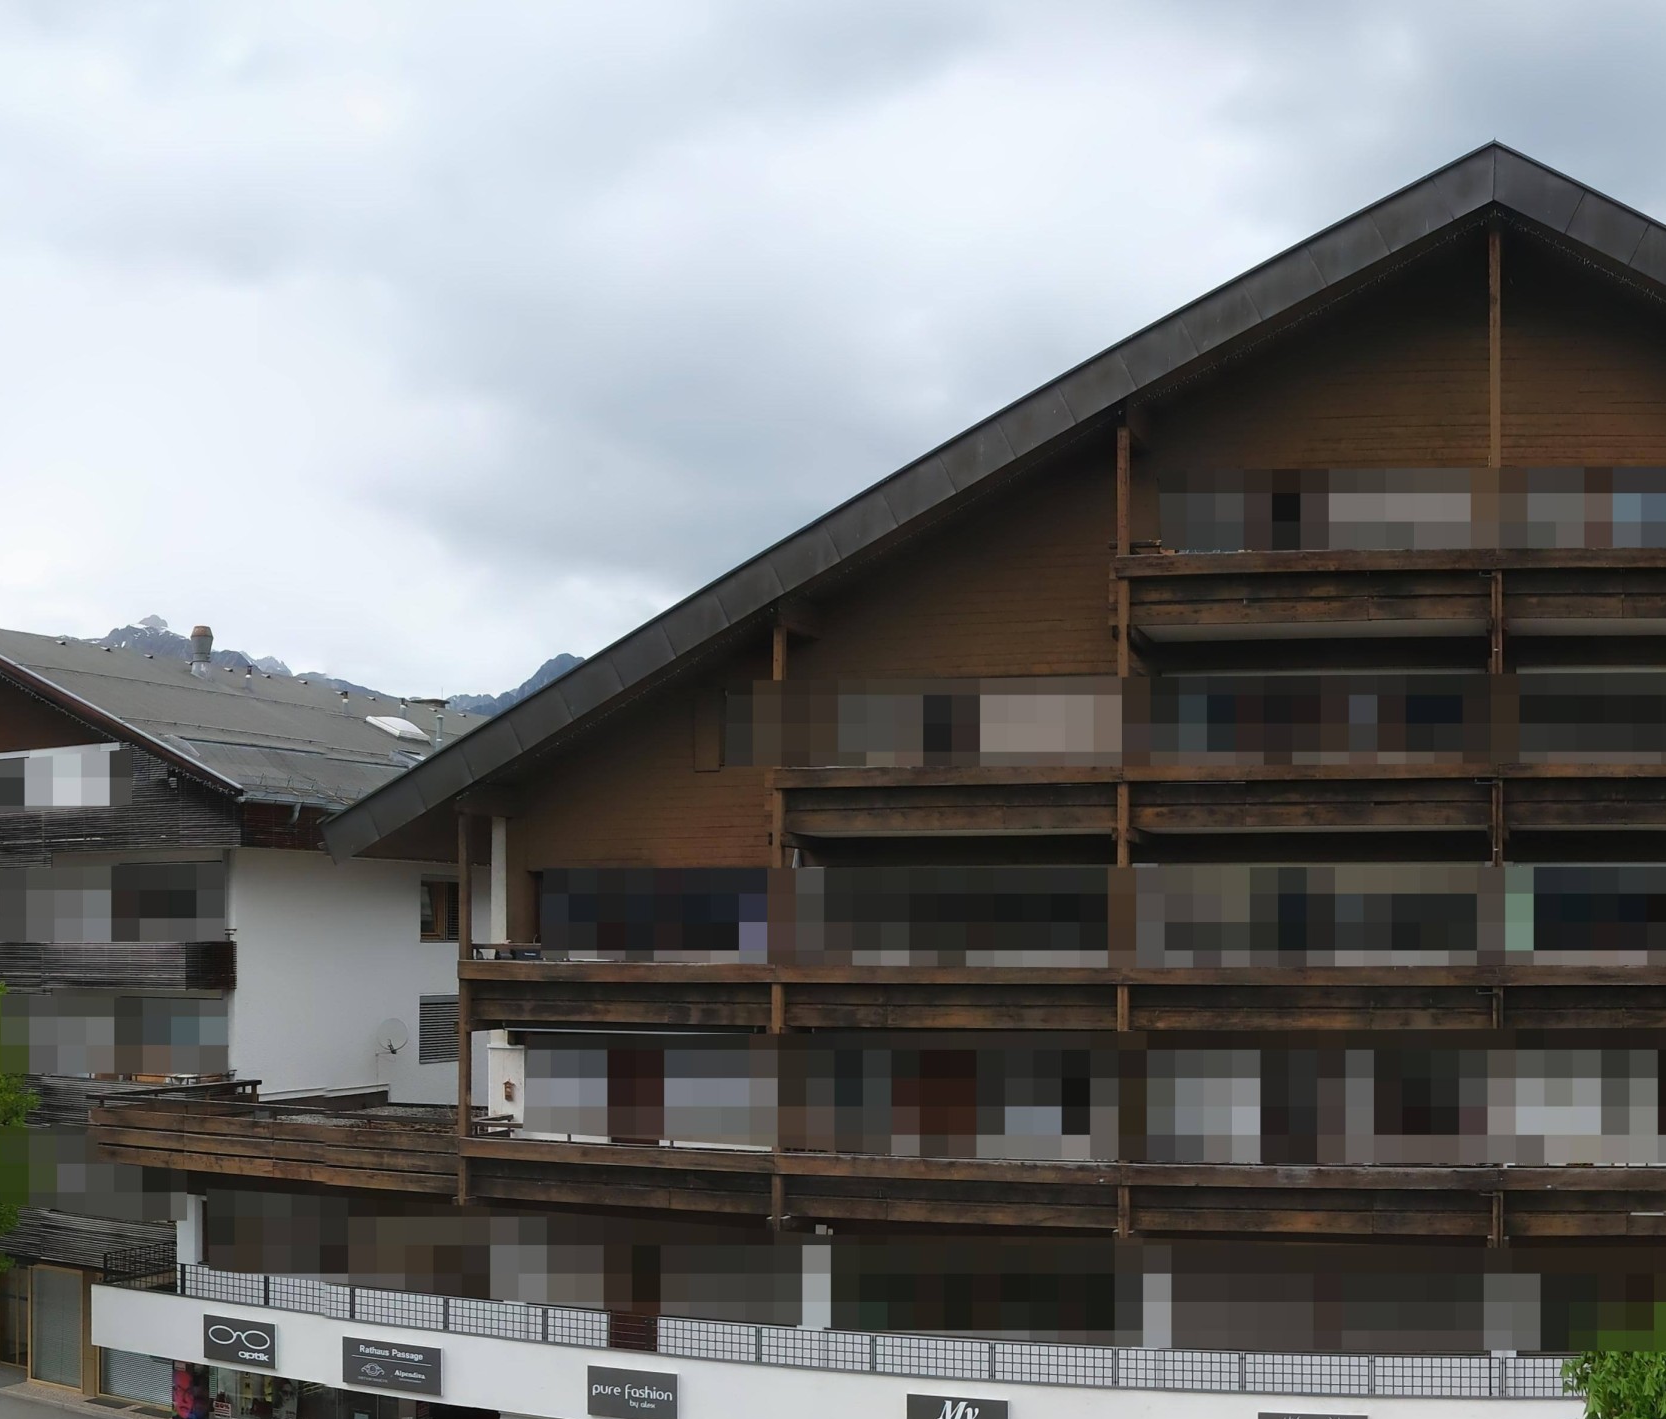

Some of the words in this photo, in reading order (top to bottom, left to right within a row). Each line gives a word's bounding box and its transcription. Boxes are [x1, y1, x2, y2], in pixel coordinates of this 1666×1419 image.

[238, 1350, 269, 1362] optik
[359, 1344, 390, 1356] Rathaus
[391, 1348, 424, 1361] Passage
[592, 1384, 622, 1396] pure
[625, 1384, 673, 1401] fashion
[629, 1400, 639, 1408] by
